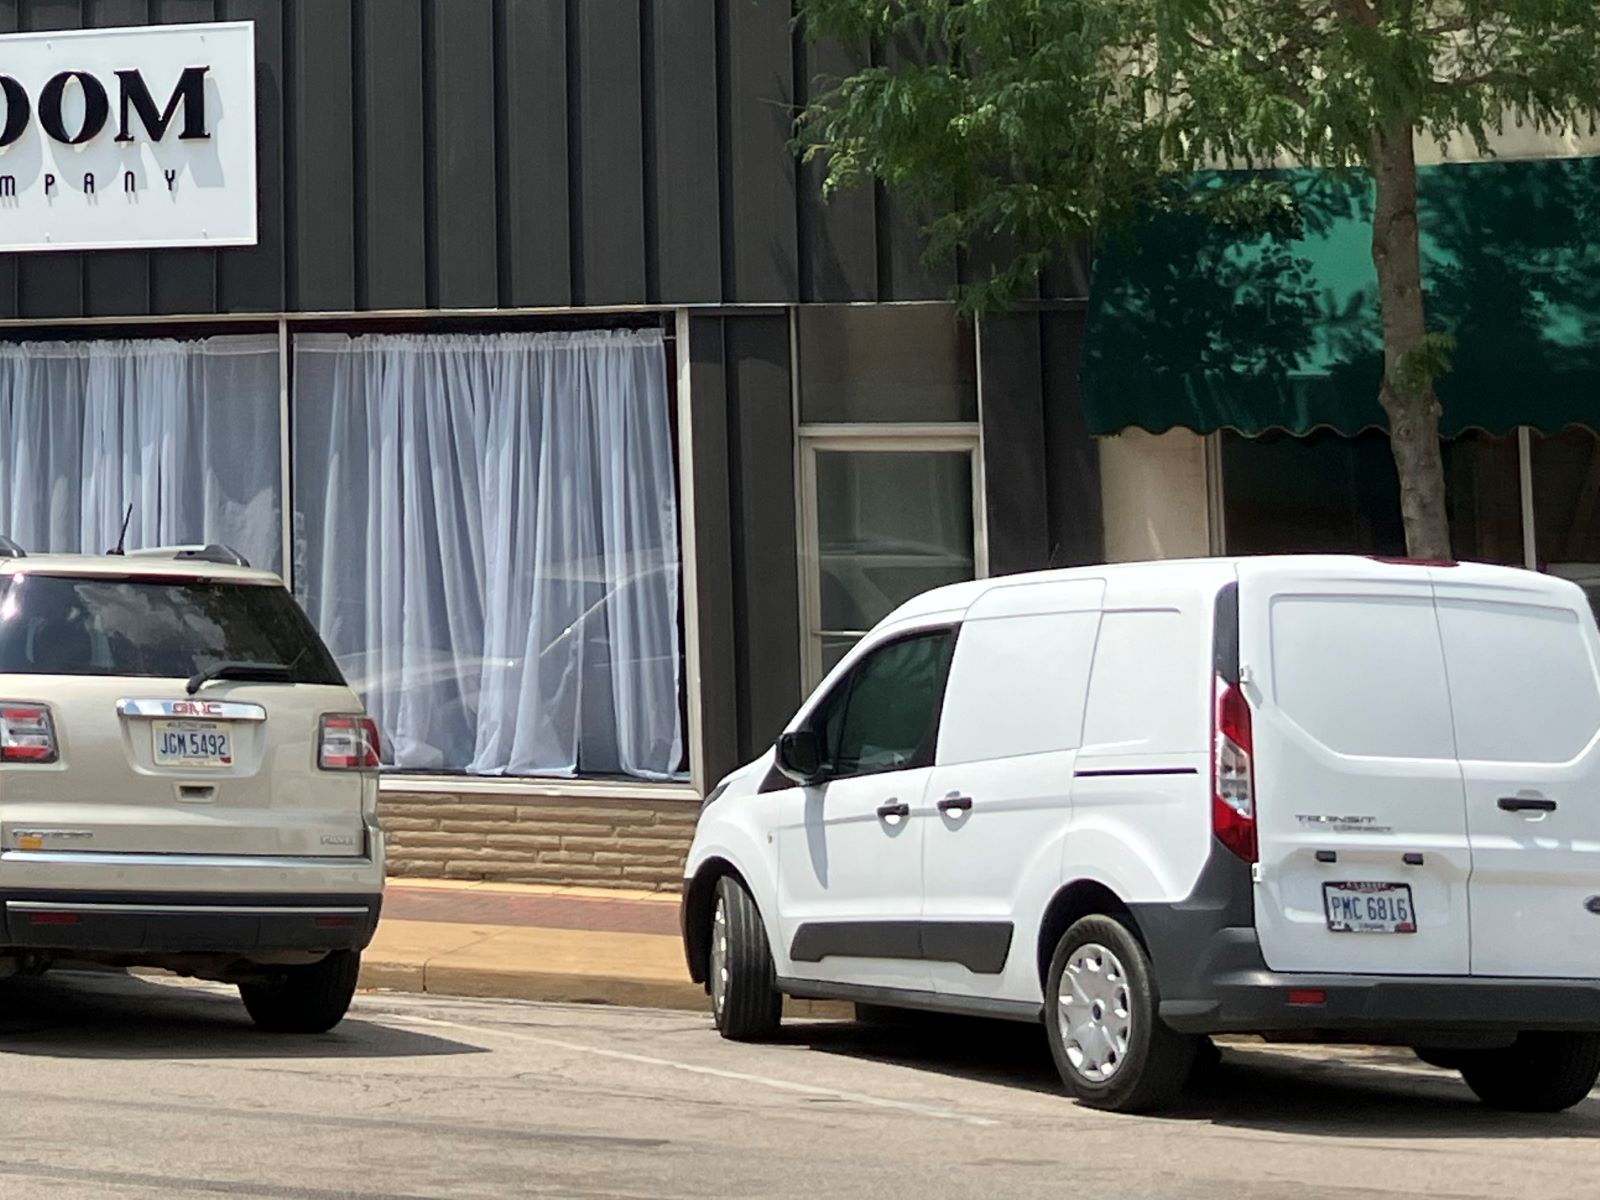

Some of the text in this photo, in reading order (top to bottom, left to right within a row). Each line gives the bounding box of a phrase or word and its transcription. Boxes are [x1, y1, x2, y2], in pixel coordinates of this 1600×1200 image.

[190, 733, 227, 756] 5492
[1331, 896, 1408, 921] PMC 6816
